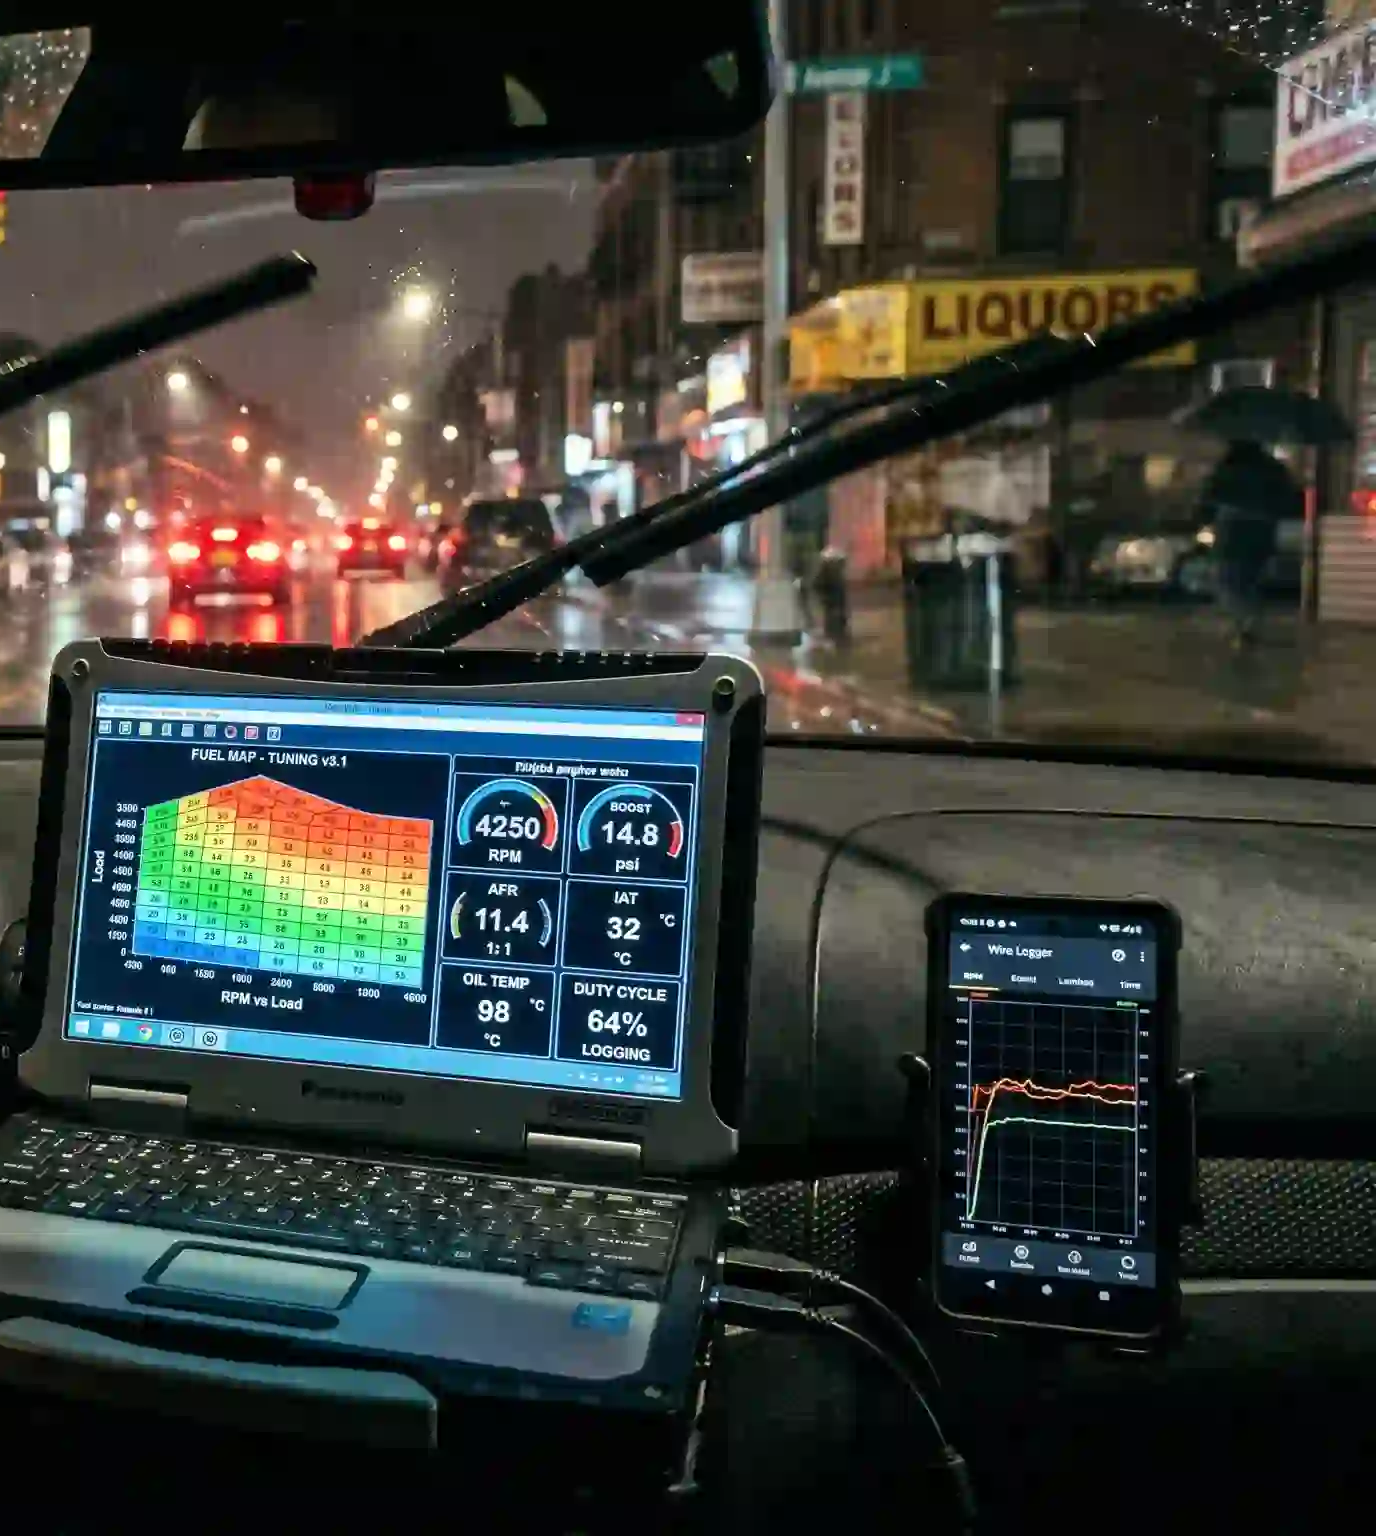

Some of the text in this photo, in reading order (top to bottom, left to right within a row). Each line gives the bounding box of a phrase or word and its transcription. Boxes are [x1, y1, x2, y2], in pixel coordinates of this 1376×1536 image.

[191, 748, 225, 761] FUEL
[228, 750, 256, 763] MAP
[268, 752, 318, 766] TUNING
[321, 756, 347, 768] v3.1
[610, 801, 652, 814] BOOST
[475, 814, 540, 840] 4250
[601, 820, 659, 846] 14.8
[488, 849, 522, 864] RPM
[615, 857, 640, 873] psi
[92, 851, 105, 882] Load
[488, 883, 519, 897] AFR
[613, 890, 639, 905] IAT
[475, 907, 529, 934] 11.4
[606, 913, 676, 941] 32 °C
[121, 948, 126, 956] 0
[614, 951, 632, 966] °C
[988, 944, 1053, 958] Wire Logger
[463, 973, 530, 990] OIL TEMP
[222, 991, 303, 1010] RPM vs Load
[574, 982, 668, 1002] DUTY CYCLE
[477, 998, 545, 1023] 98 °C
[587, 1009, 647, 1037] 64%
[484, 1033, 501, 1047] °C
[582, 1044, 650, 1062] LOGGING
